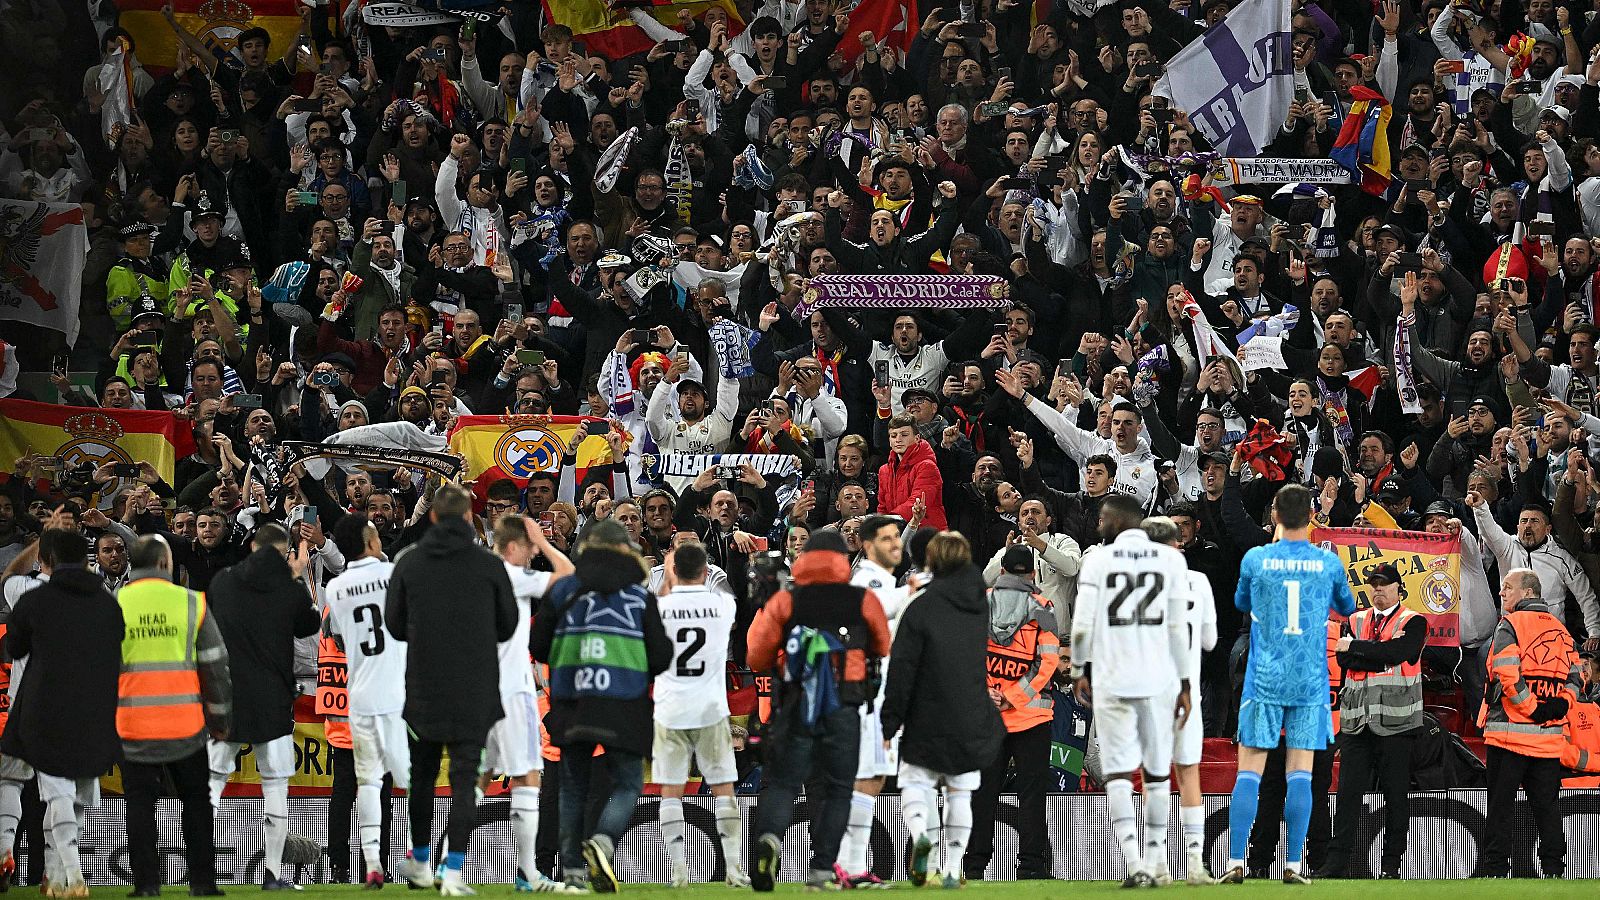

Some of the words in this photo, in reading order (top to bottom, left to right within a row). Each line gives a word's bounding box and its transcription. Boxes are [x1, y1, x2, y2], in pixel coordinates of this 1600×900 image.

[370, 6, 420, 16] REAL
[1242, 164, 1287, 177] HALA
[823, 283, 874, 298] REAL
[873, 283, 949, 298] MADRID
[1347, 540, 1384, 564] LA
[1262, 558, 1324, 572] COURTOIS
[1105, 571, 1164, 627] 22
[1282, 579, 1303, 635] 1
[139, 613, 167, 625] HEAD
[129, 626, 178, 640] STEWARD
[353, 603, 385, 656] 3
[676, 626, 706, 677] 2
[1050, 745, 1070, 765] TV
